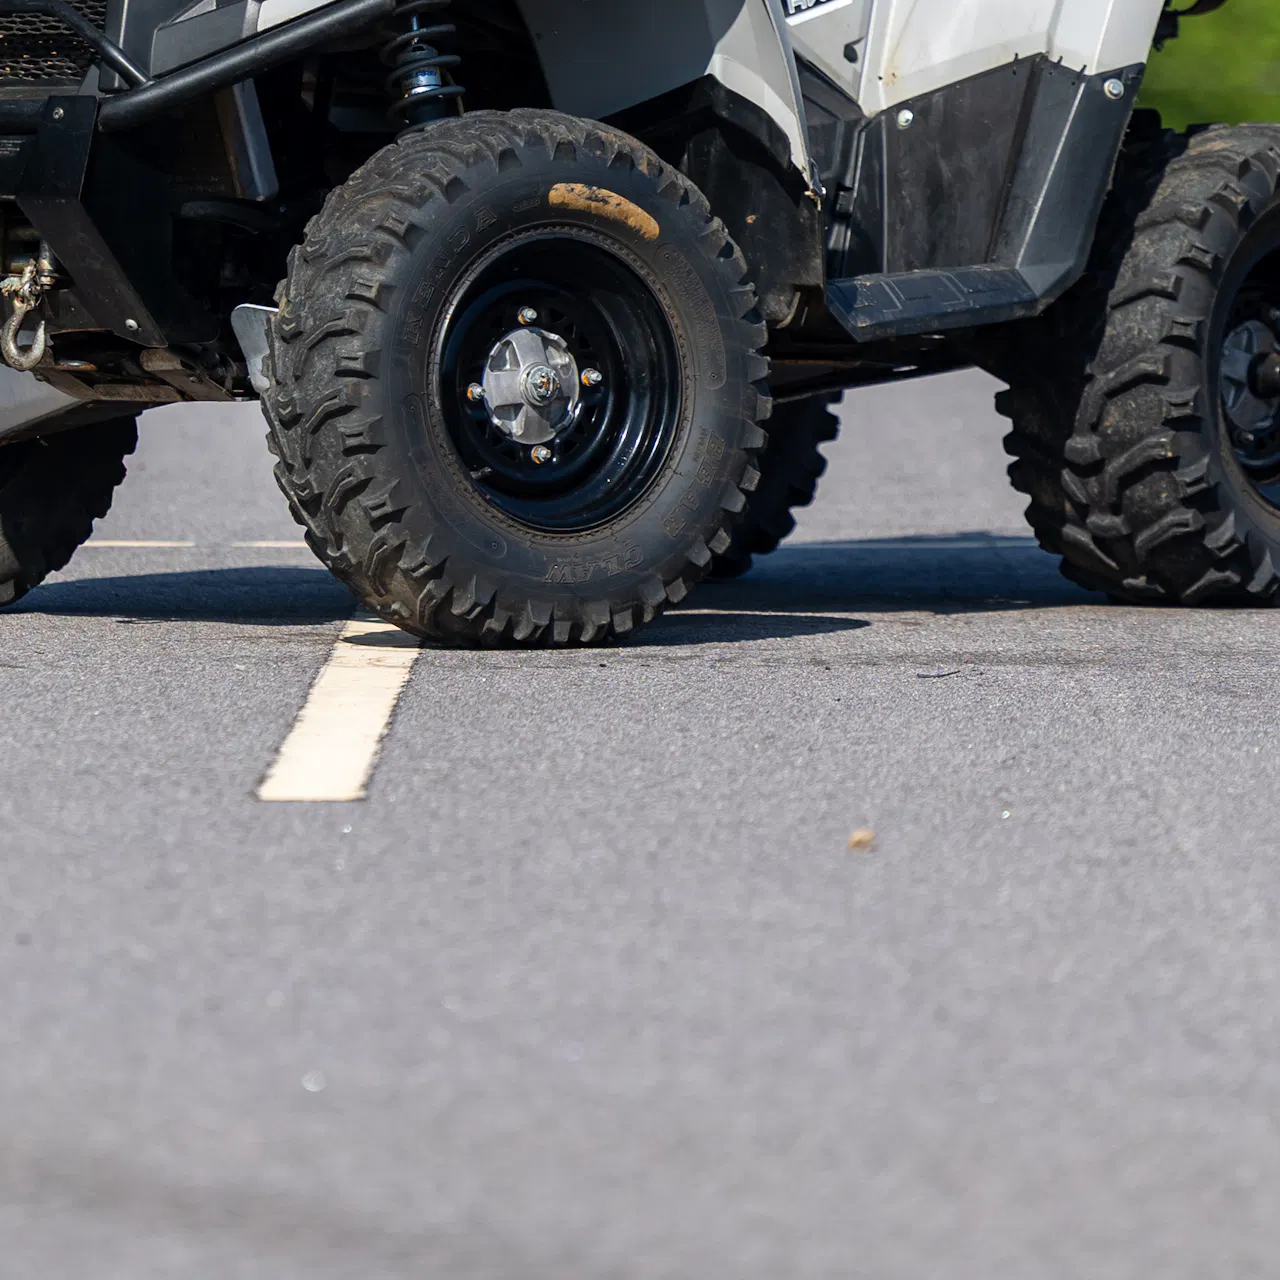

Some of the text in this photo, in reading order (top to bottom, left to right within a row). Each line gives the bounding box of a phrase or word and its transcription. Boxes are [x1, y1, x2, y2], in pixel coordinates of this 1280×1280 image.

[408, 206, 505, 346] KENDA
[661, 430, 726, 538] BEAR
[543, 539, 645, 585] CLAW
